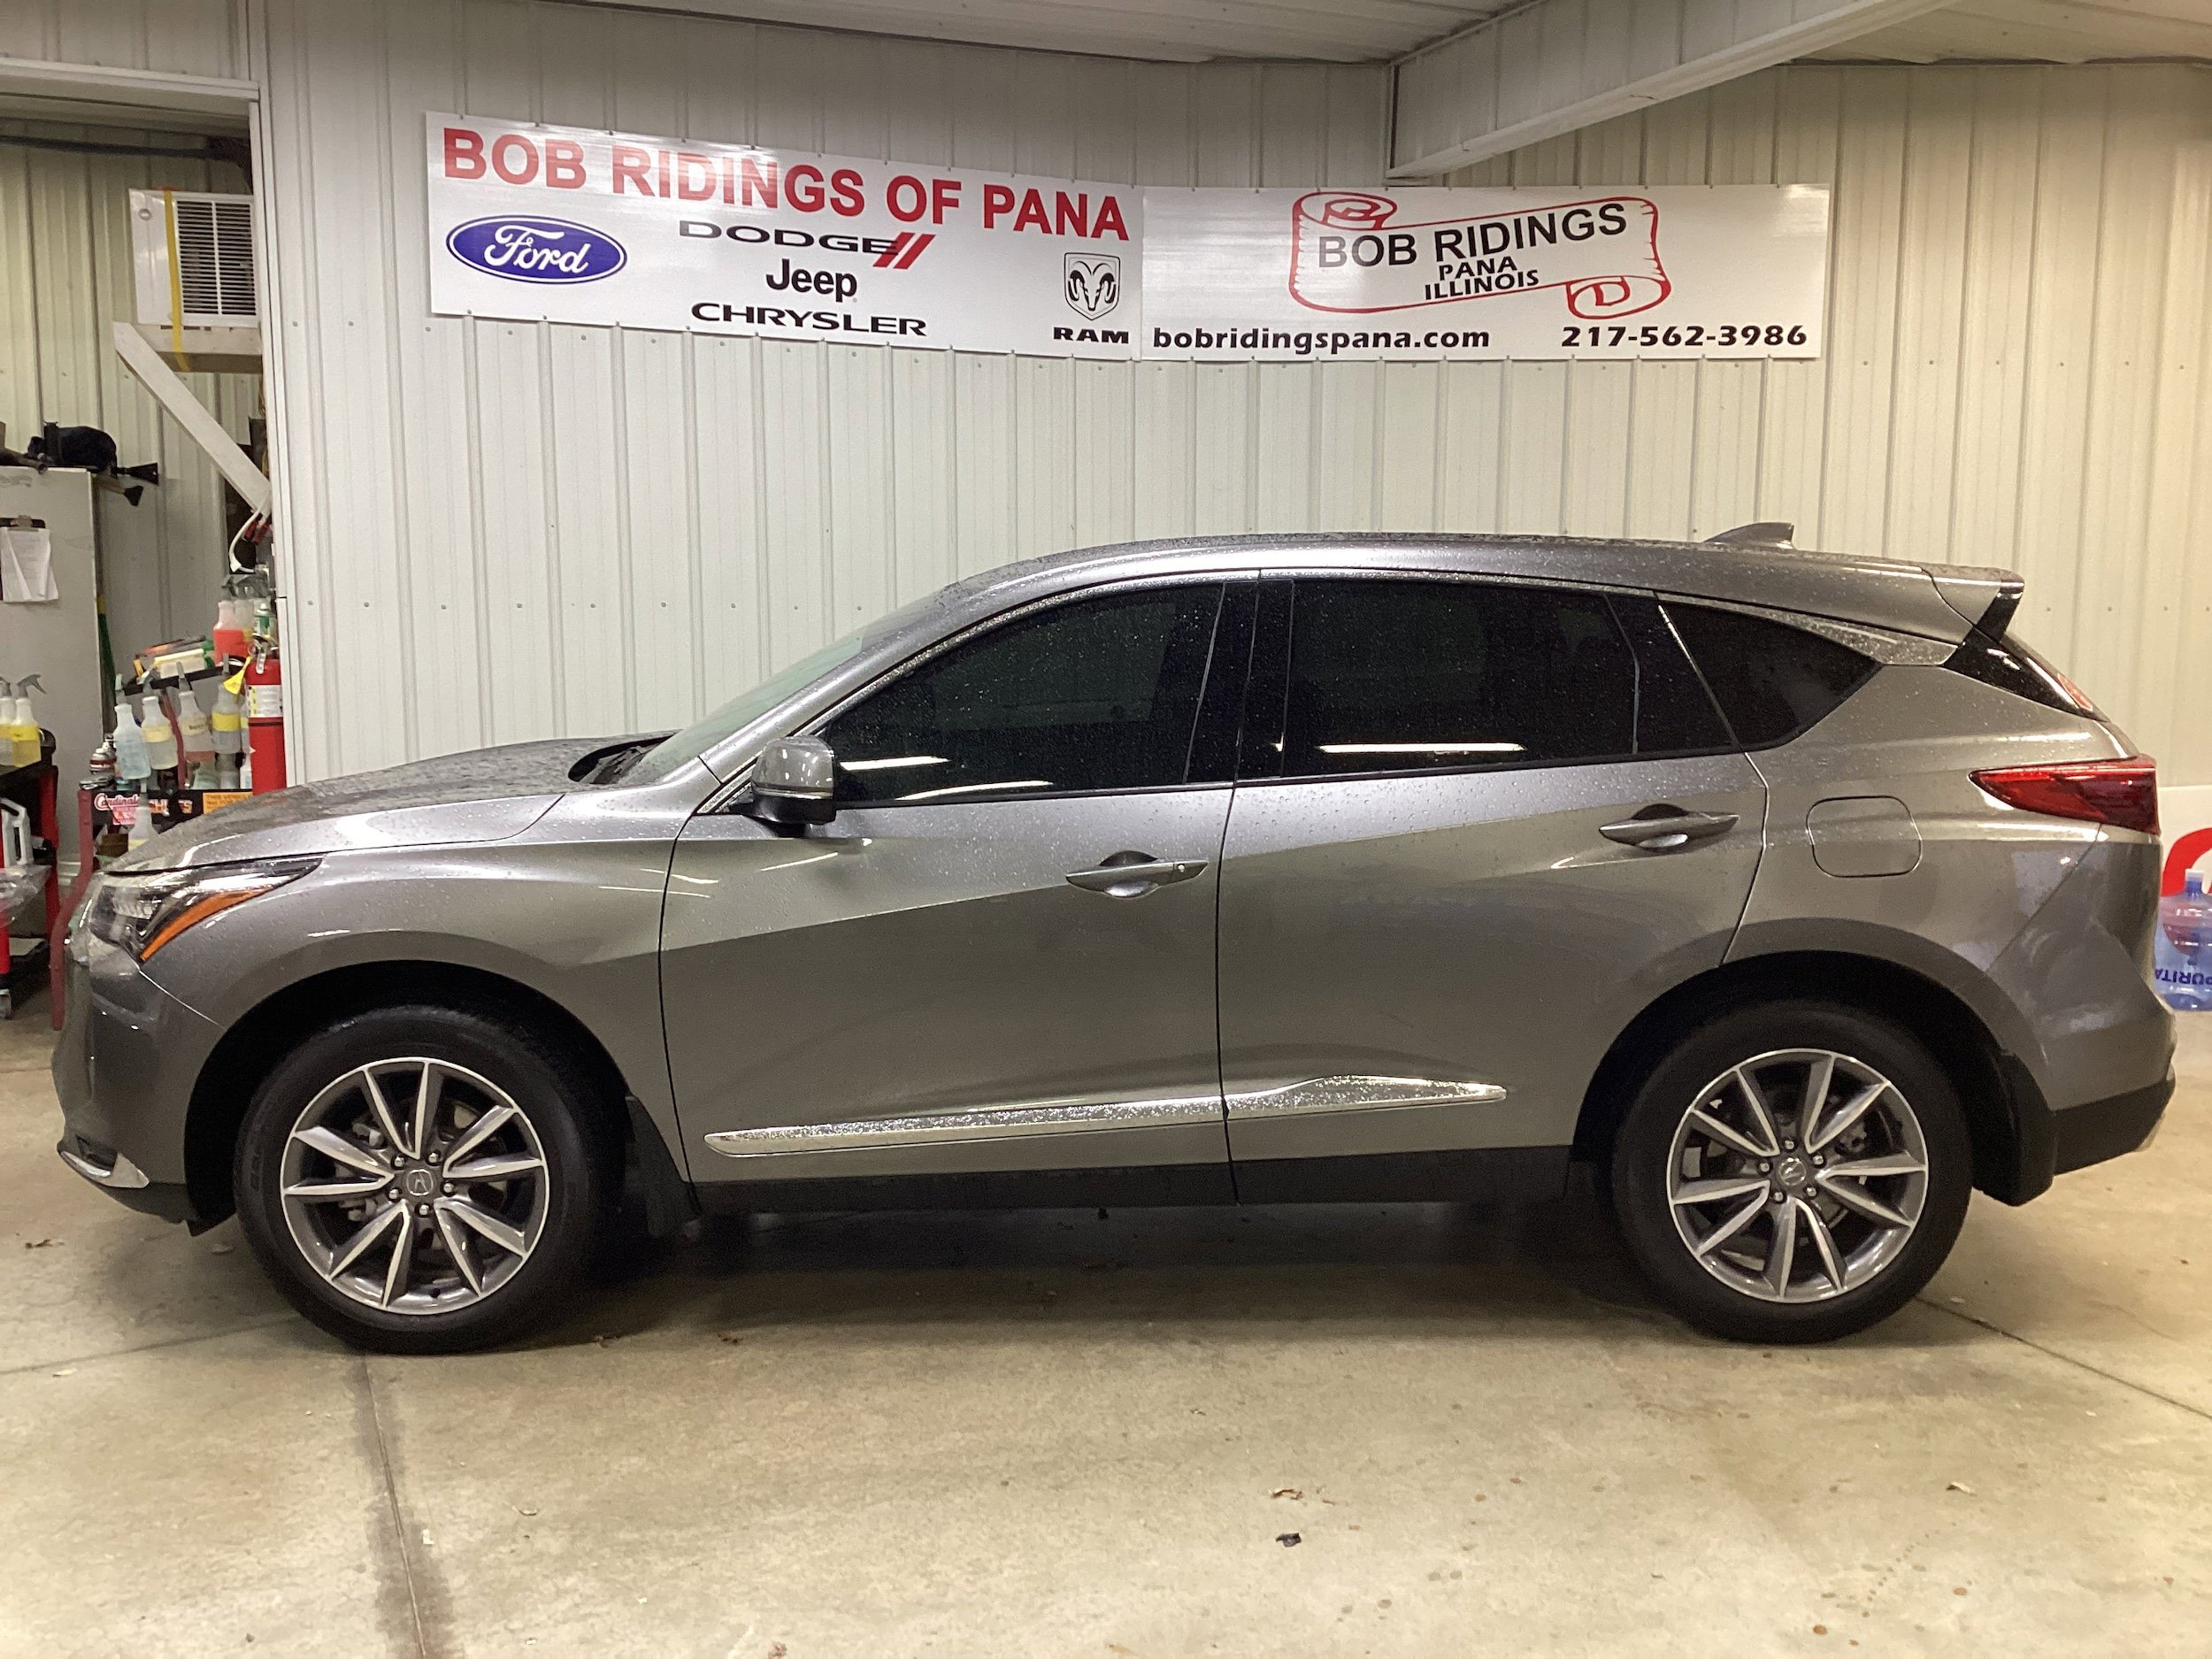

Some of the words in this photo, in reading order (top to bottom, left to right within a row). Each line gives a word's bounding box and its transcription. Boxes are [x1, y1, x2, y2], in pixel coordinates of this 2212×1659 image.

[443, 127, 587, 189] BOB
[612, 145, 864, 217] RIDINGS
[886, 175, 962, 225] OF
[983, 183, 1130, 242] PANA
[484, 225, 590, 274] Ford
[680, 220, 899, 255] DODGE
[1318, 234, 1417, 268] BOB
[1433, 203, 1627, 263] RIDINGS
[766, 258, 857, 303] Jeep
[1439, 256, 1517, 281] PANA
[1425, 270, 1540, 301] ILLINOIS
[691, 303, 926, 336] CHRYSLER
[1053, 326, 1129, 344] RAM
[1153, 327, 1489, 354] bobridingspana.com
[1561, 325, 1807, 348] 217-562-3986
[94, 793, 139, 810] Cardinal
